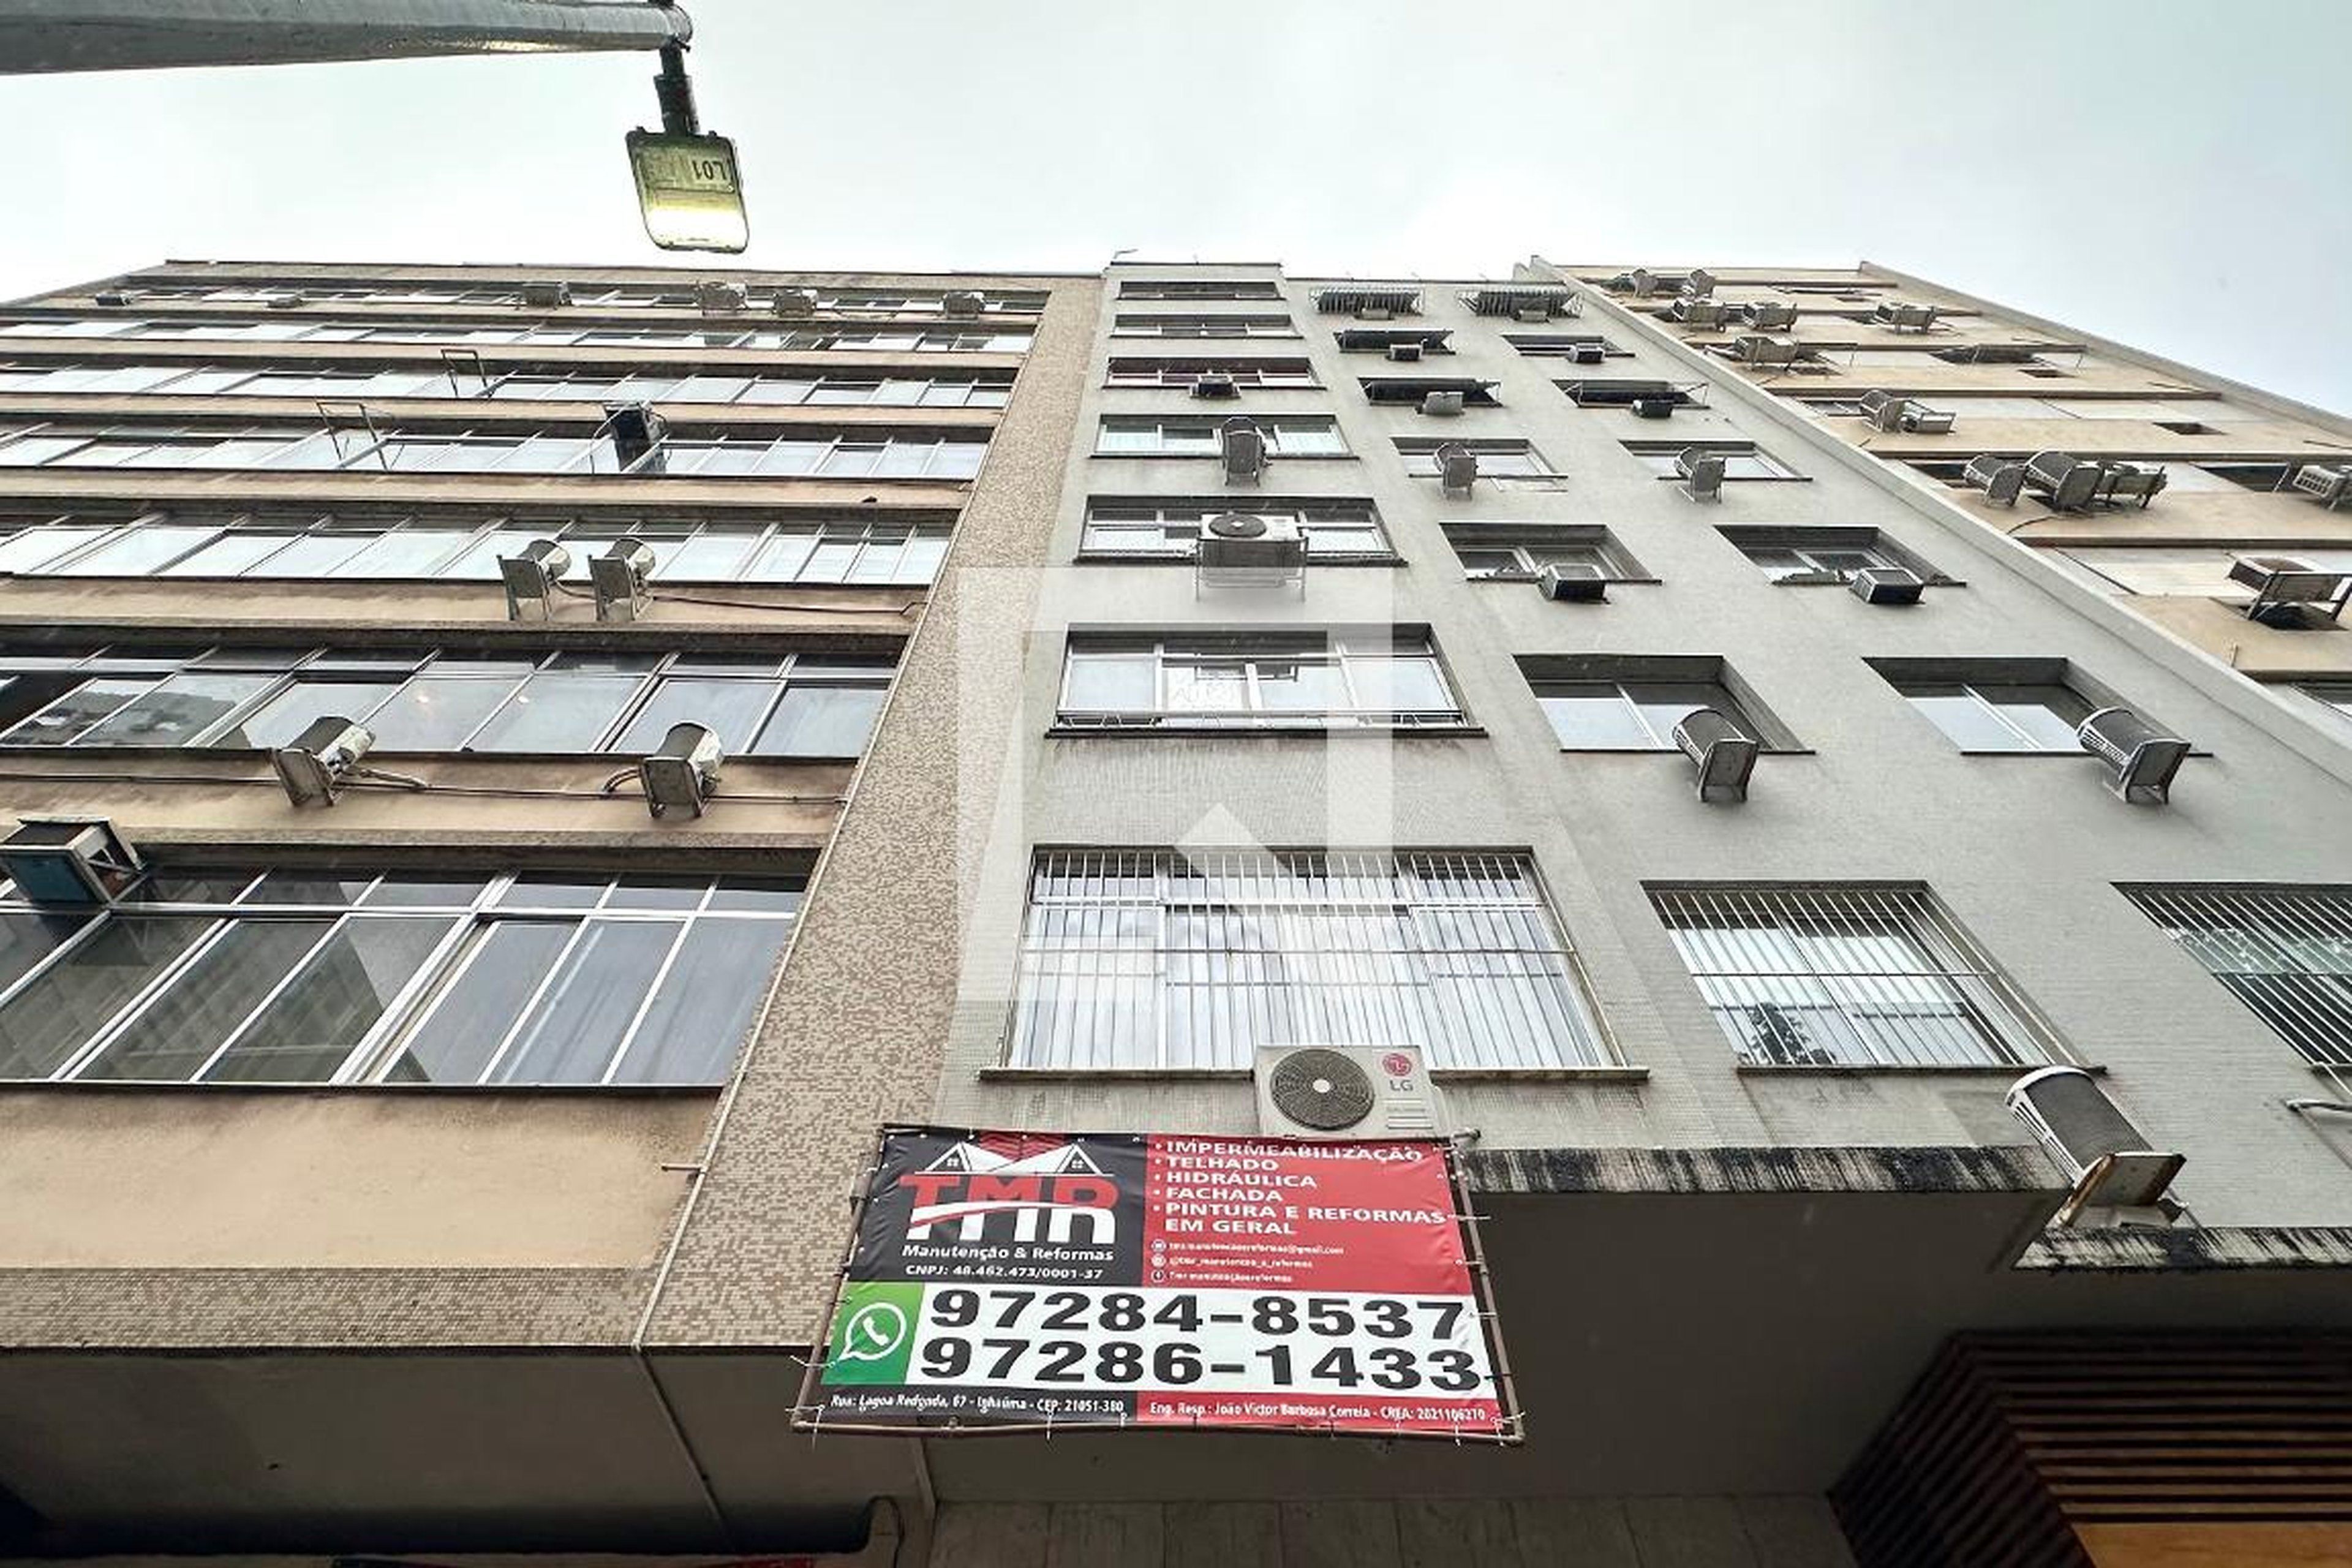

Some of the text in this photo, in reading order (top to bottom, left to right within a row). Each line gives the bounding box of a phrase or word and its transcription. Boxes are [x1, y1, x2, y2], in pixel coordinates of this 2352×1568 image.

[1389, 1079, 1414, 1091] LG
[1167, 1140, 1422, 1163] IMPERMEABILIZAÇÃO
[1167, 1156, 1279, 1171] TELHADO
[1167, 1170, 1317, 1187] HIDRÁULICA
[1166, 1188, 1283, 1201] FACHADA
[899, 1174, 1120, 1244] TMR
[1165, 1202, 1447, 1224] PINTURA E REFORMAS
[1165, 1219, 1298, 1234] EM GERAL
[902, 1245, 1114, 1261] Manutenção & Reformas
[905, 1265, 949, 1276] CNPJ:
[930, 1289, 1464, 1340] 97284-8537
[920, 1336, 1481, 1391] 97286-1433
[831, 1394, 856, 1407] Rua:
[859, 1394, 894, 1409] Lagoa
[1036, 1398, 1061, 1411] CEP:
[1150, 1402, 1174, 1414] Eng.
[1215, 1402, 1242, 1414] João
[1245, 1403, 1278, 1415] Victor
[1280, 1403, 1326, 1416] Barbosa
